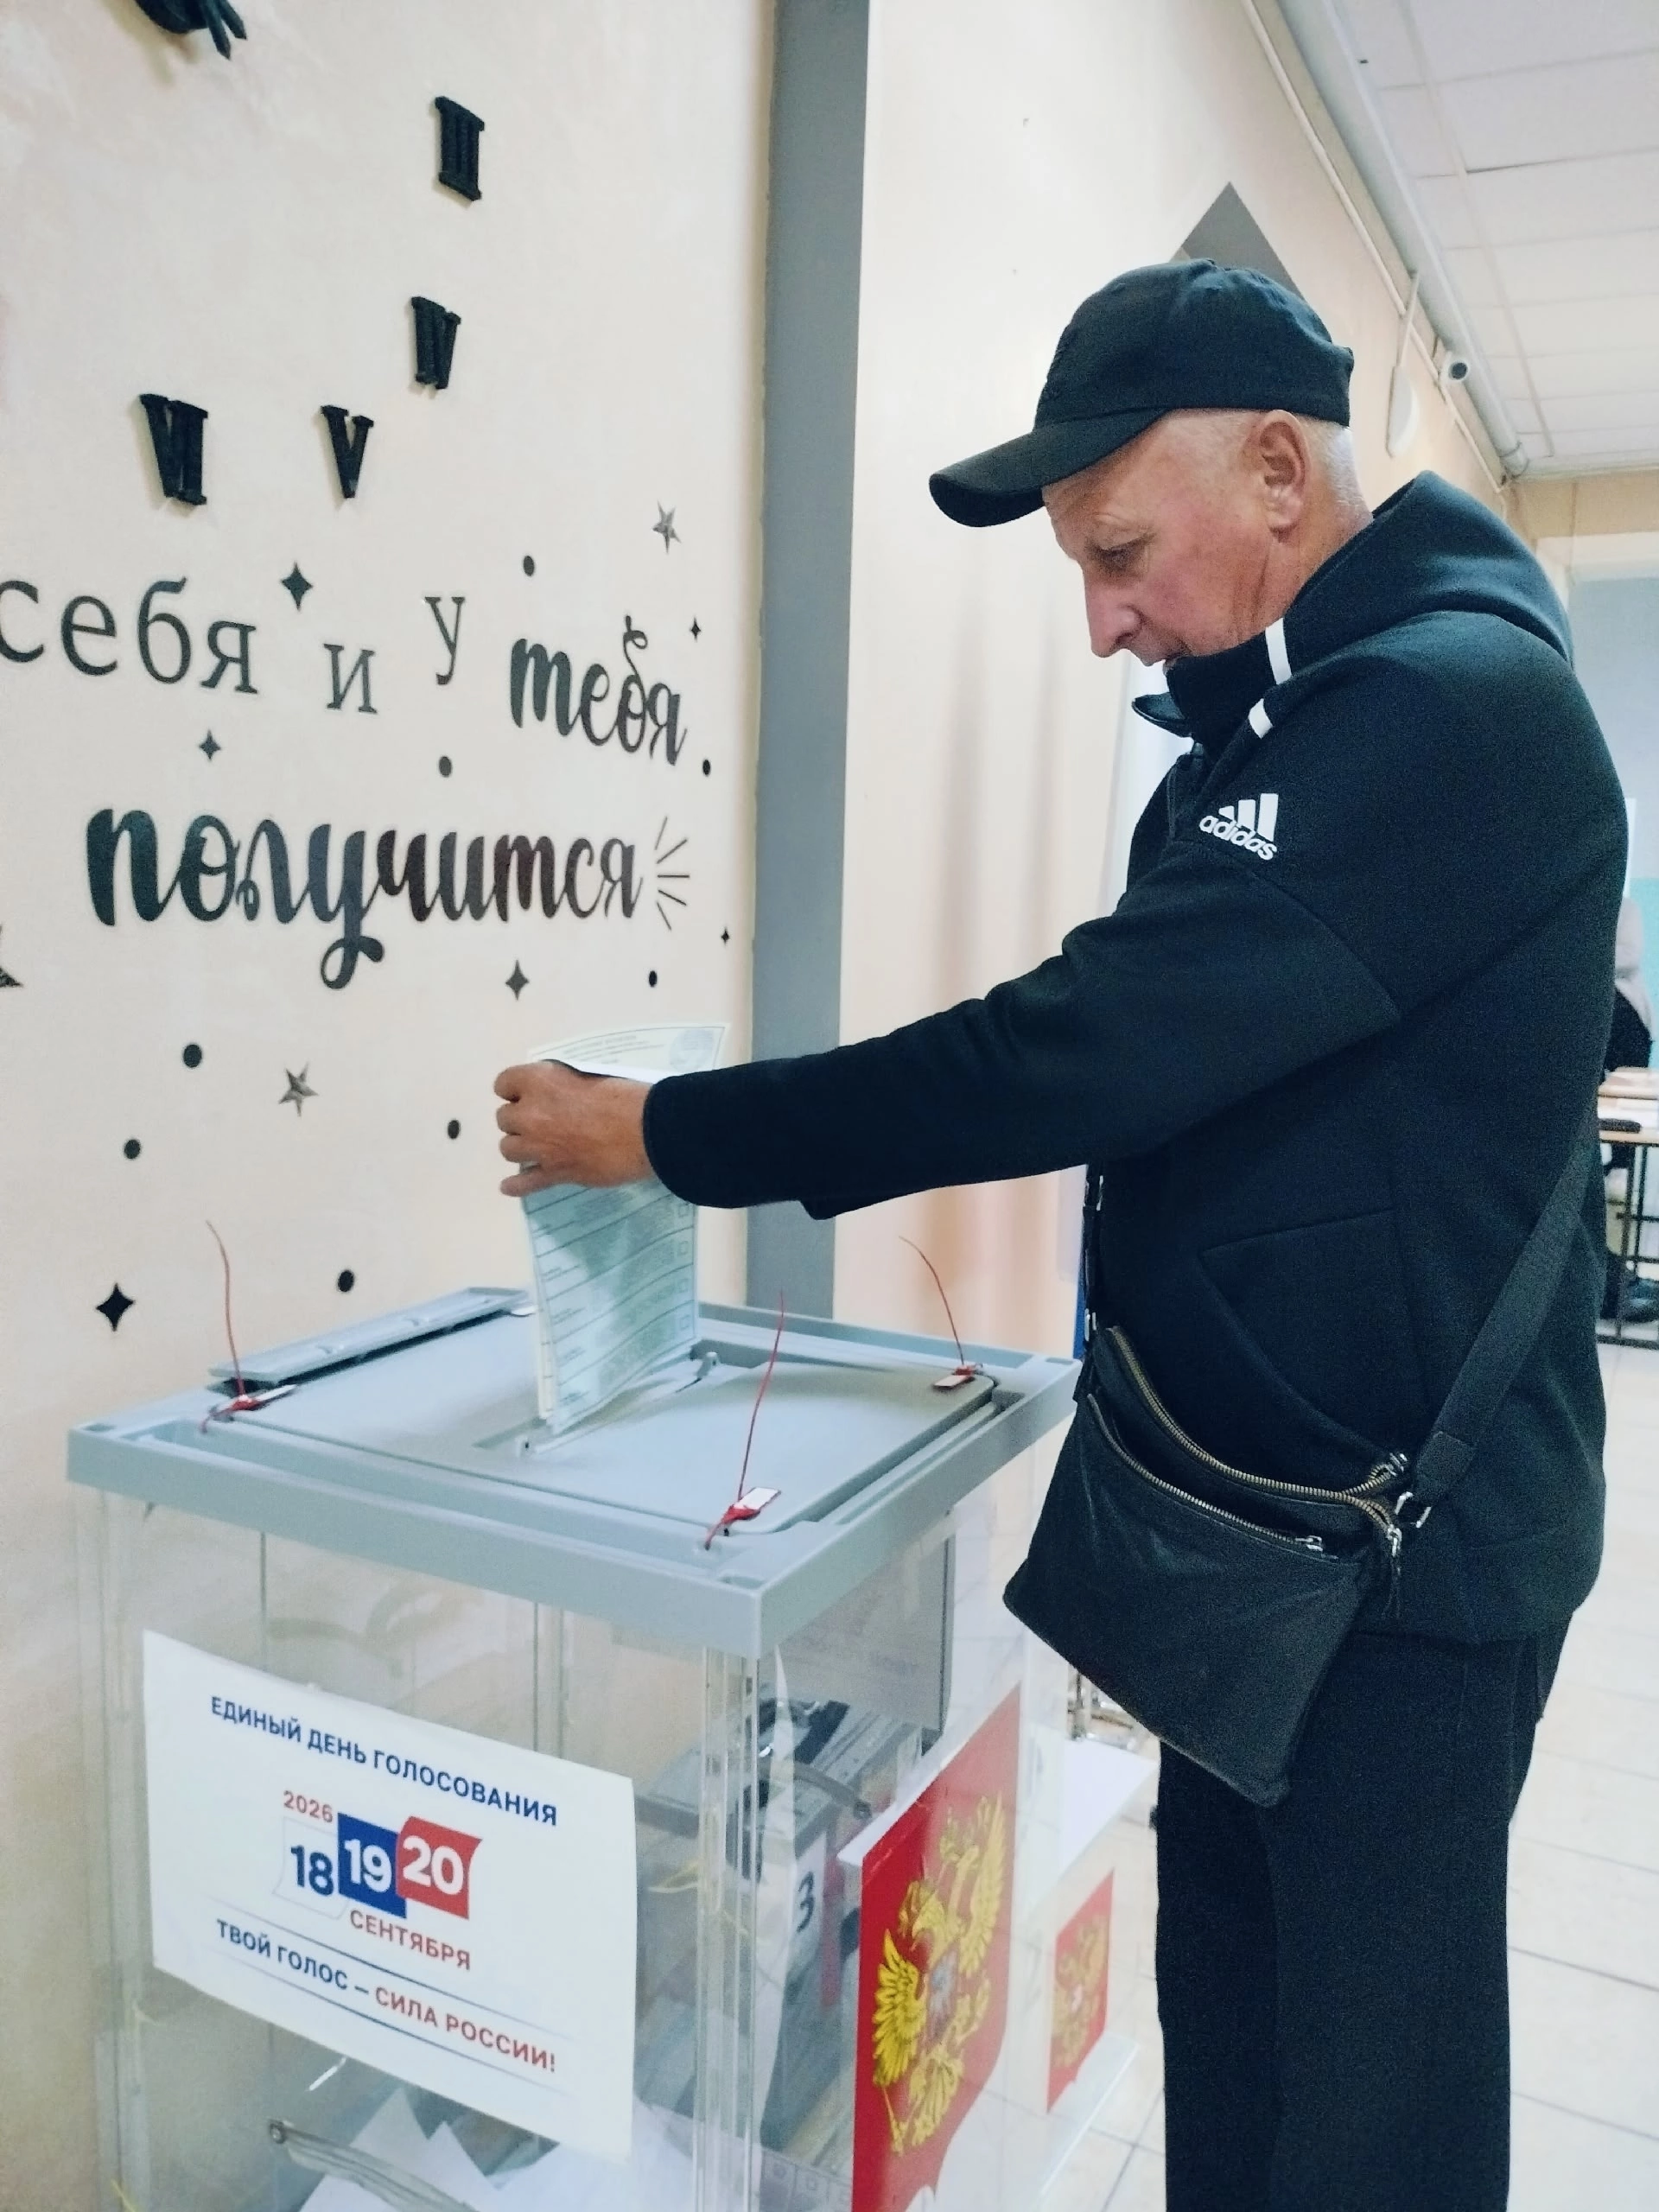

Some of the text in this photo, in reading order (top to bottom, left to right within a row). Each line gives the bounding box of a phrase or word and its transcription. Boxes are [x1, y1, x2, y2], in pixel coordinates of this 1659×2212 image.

[435, 96, 485, 201] III
[411, 296, 461, 390] IV
[321, 405, 374, 499] V
[0, 577, 688, 766] себя и у тебя
[1198, 815, 1277, 861] adidas
[86, 809, 643, 990] получится
[212, 1696, 556, 1826] ЕДИНЫЙ ДЕНЬ ГОЛОСОВАНИЯ
[283, 1789, 334, 1823] 2026
[290, 1834, 464, 1897] 18 19 20
[349, 1910, 471, 1970] СЕНТЯБРЯ
[216, 1918, 271, 1959] ТВОЙ
[277, 1945, 348, 1990] ГОЛОС
[375, 1986, 439, 2028] СИЛА
[445, 2013, 556, 2073] РОССИИ!
